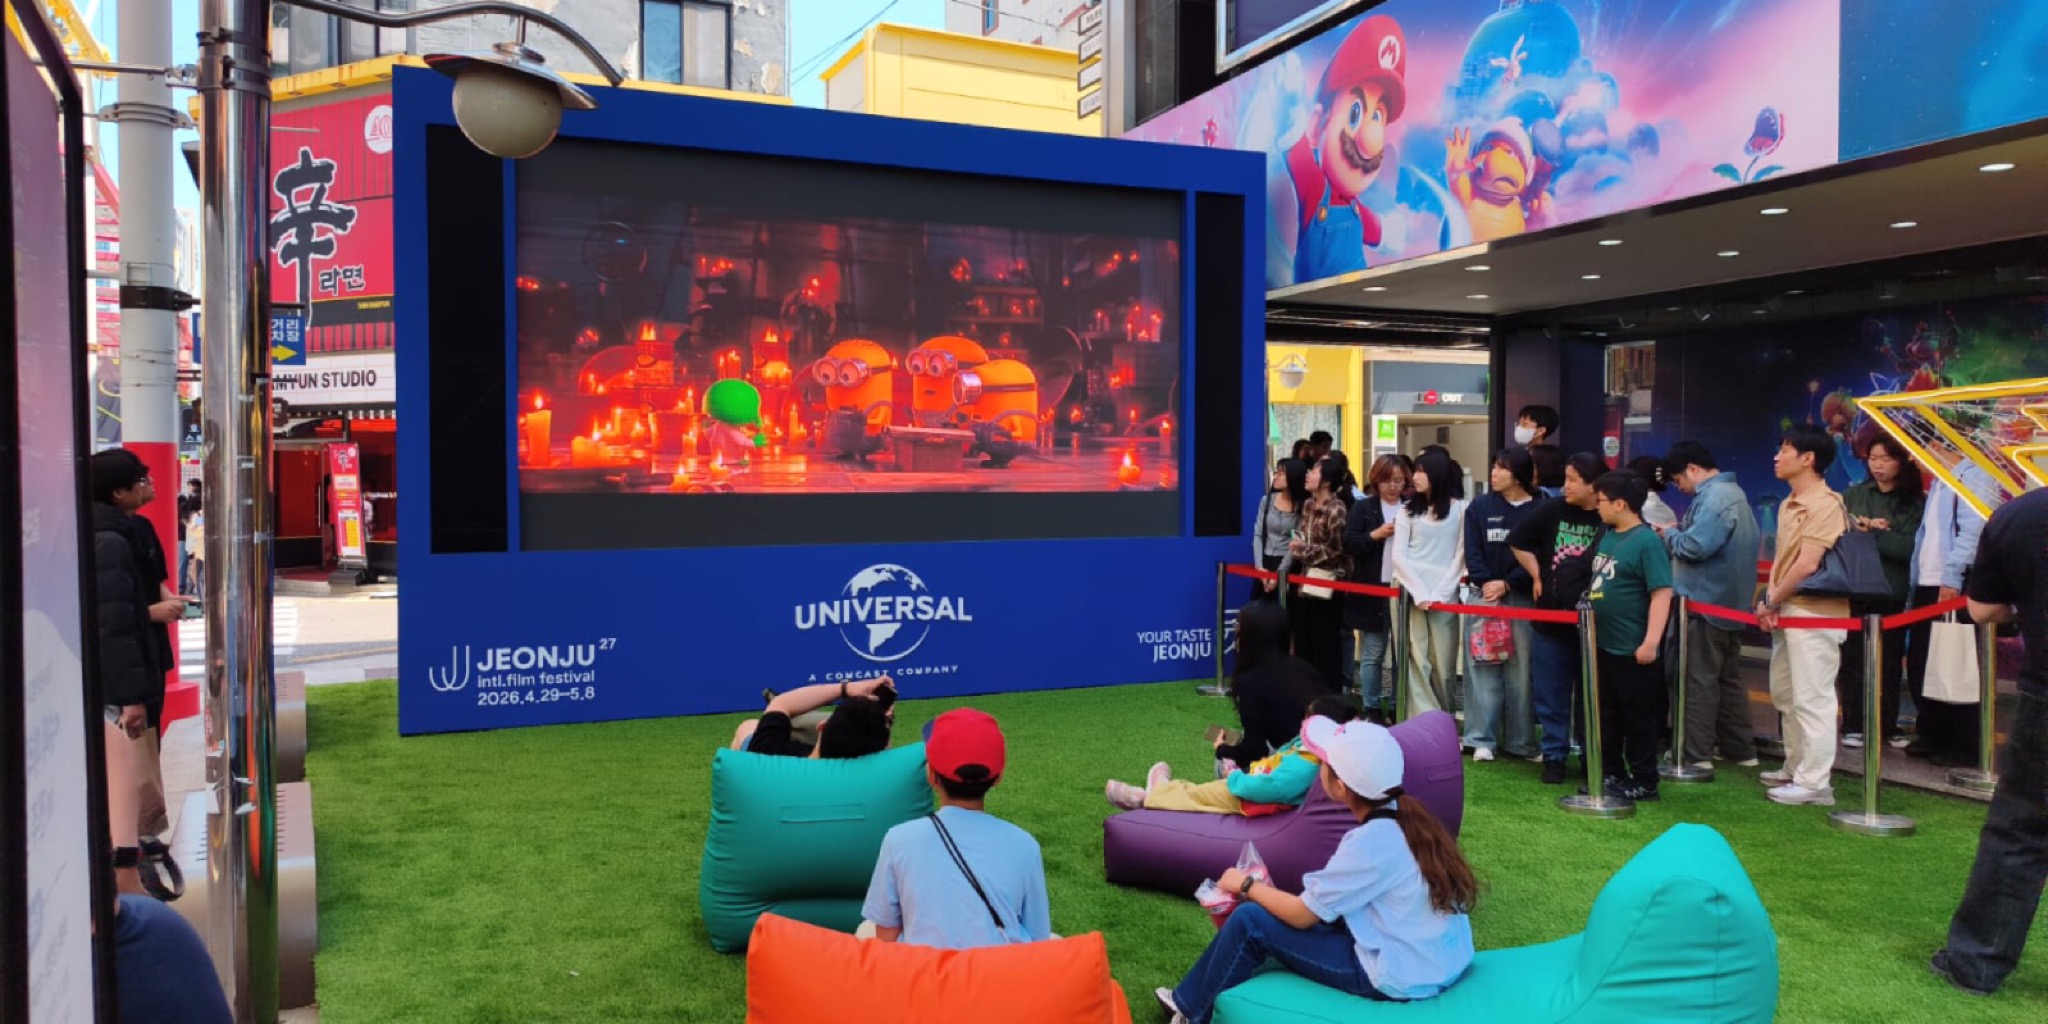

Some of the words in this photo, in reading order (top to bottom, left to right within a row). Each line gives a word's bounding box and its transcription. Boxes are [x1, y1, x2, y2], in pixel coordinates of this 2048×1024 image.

[270, 146, 358, 331] 辛
[319, 264, 366, 296] 라면
[272, 372, 318, 391] MYUN
[321, 370, 377, 388] STUDIO
[794, 595, 973, 629] UNIVERSAL
[1136, 630, 1172, 643] YOUR
[1174, 628, 1212, 642] TASTE
[476, 644, 595, 672] JEONJU
[599, 638, 617, 650] 27
[1153, 641, 1212, 663] JEONJU
[477, 673, 535, 688] intl.film
[539, 669, 595, 684] festival
[808, 673, 817, 682] A
[825, 669, 889, 681] COMCAST
[897, 665, 959, 676] COMPANY
